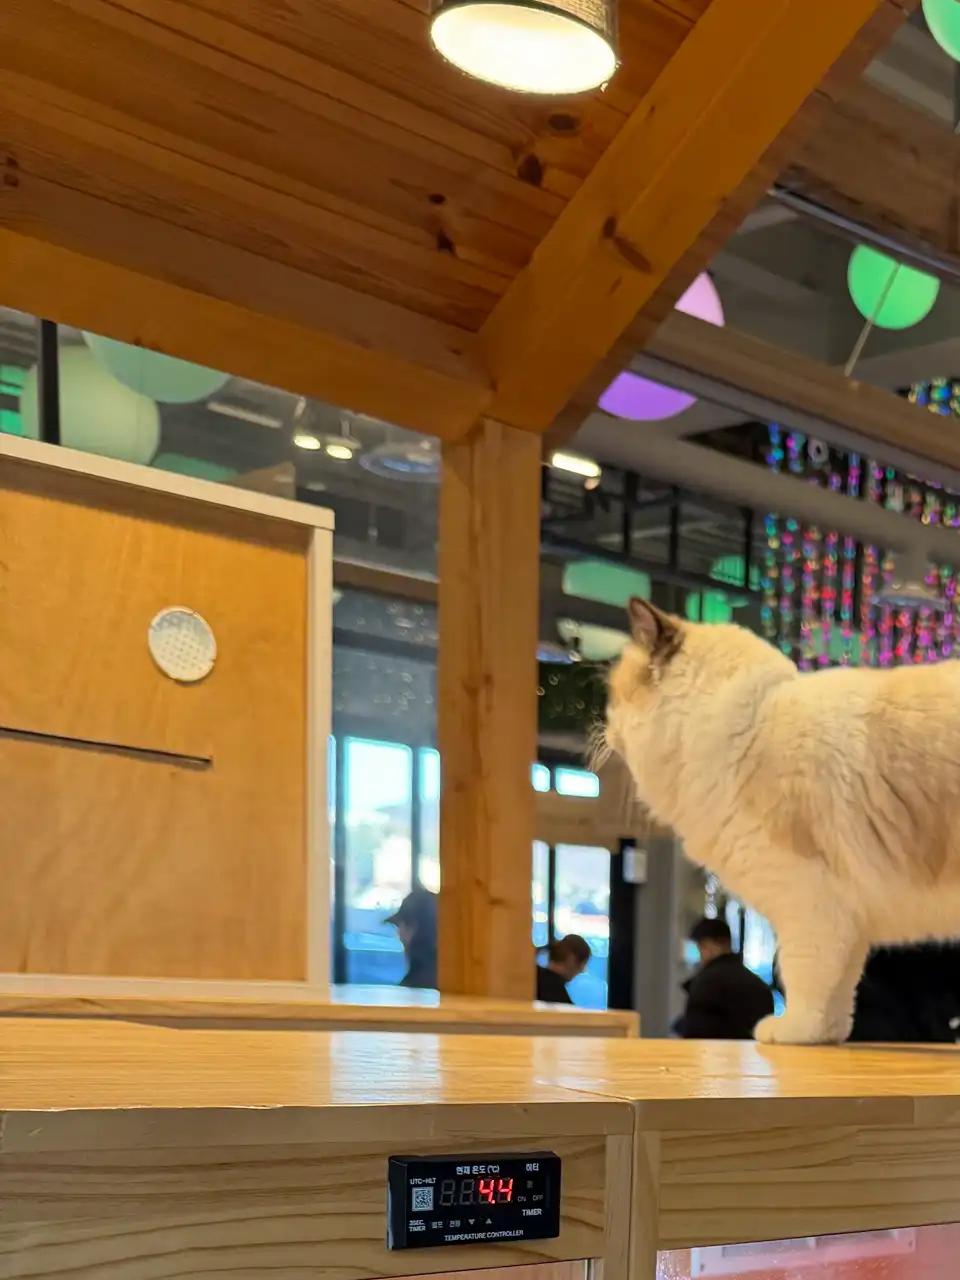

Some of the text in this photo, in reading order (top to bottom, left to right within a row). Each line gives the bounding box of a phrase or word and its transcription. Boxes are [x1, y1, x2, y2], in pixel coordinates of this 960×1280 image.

[472, 1164, 486, 1175] 온도
[522, 1208, 543, 1217] TIMER
[444, 1229, 524, 1242] TEMPERATURE CONTROLLER
